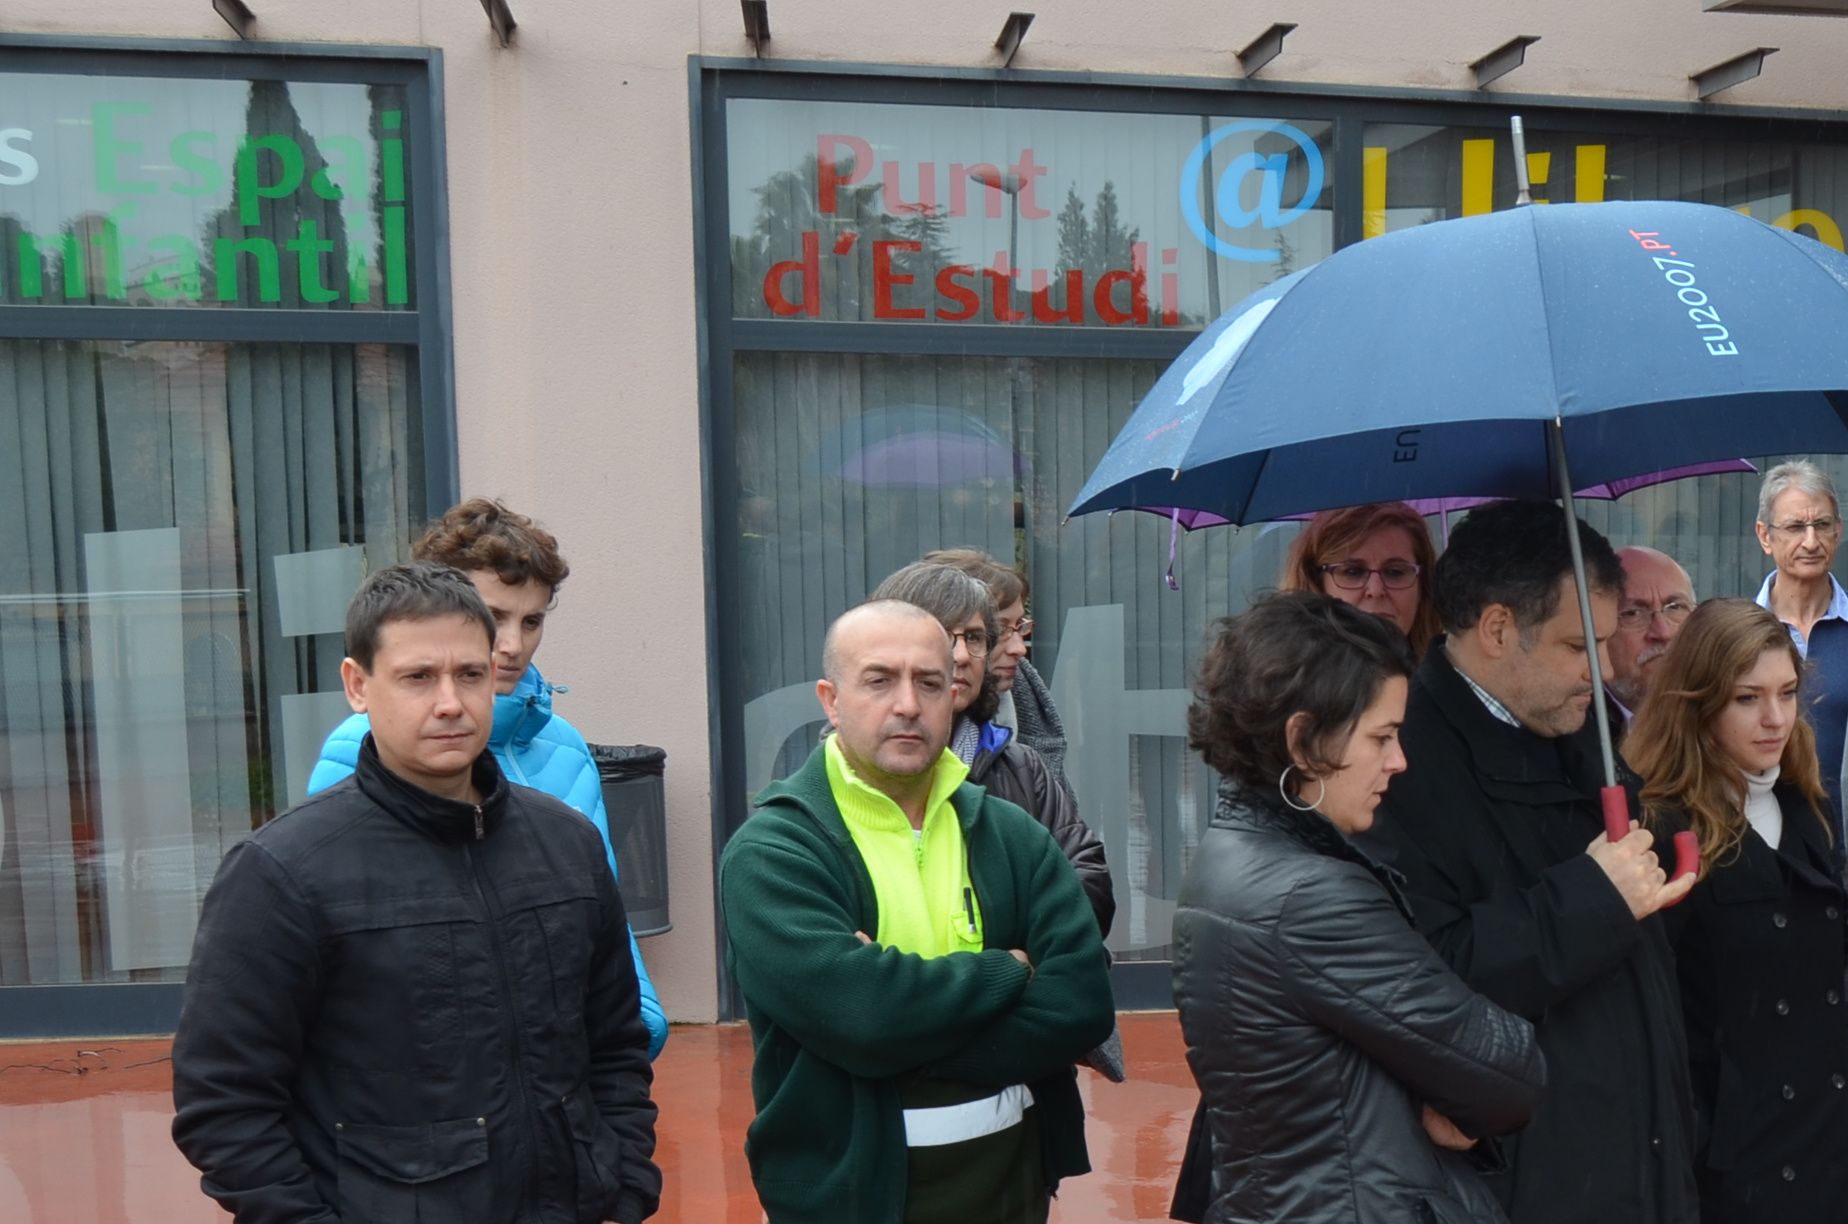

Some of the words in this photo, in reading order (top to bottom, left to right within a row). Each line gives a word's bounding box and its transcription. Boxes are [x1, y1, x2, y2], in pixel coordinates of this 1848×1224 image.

[92, 102, 406, 226] Espai
[816, 133, 1052, 220] Punt
[0, 200, 408, 304] nfantil
[763, 230, 1180, 326] d'Estudi
[1628, 228, 1740, 356] EU2007.PT
